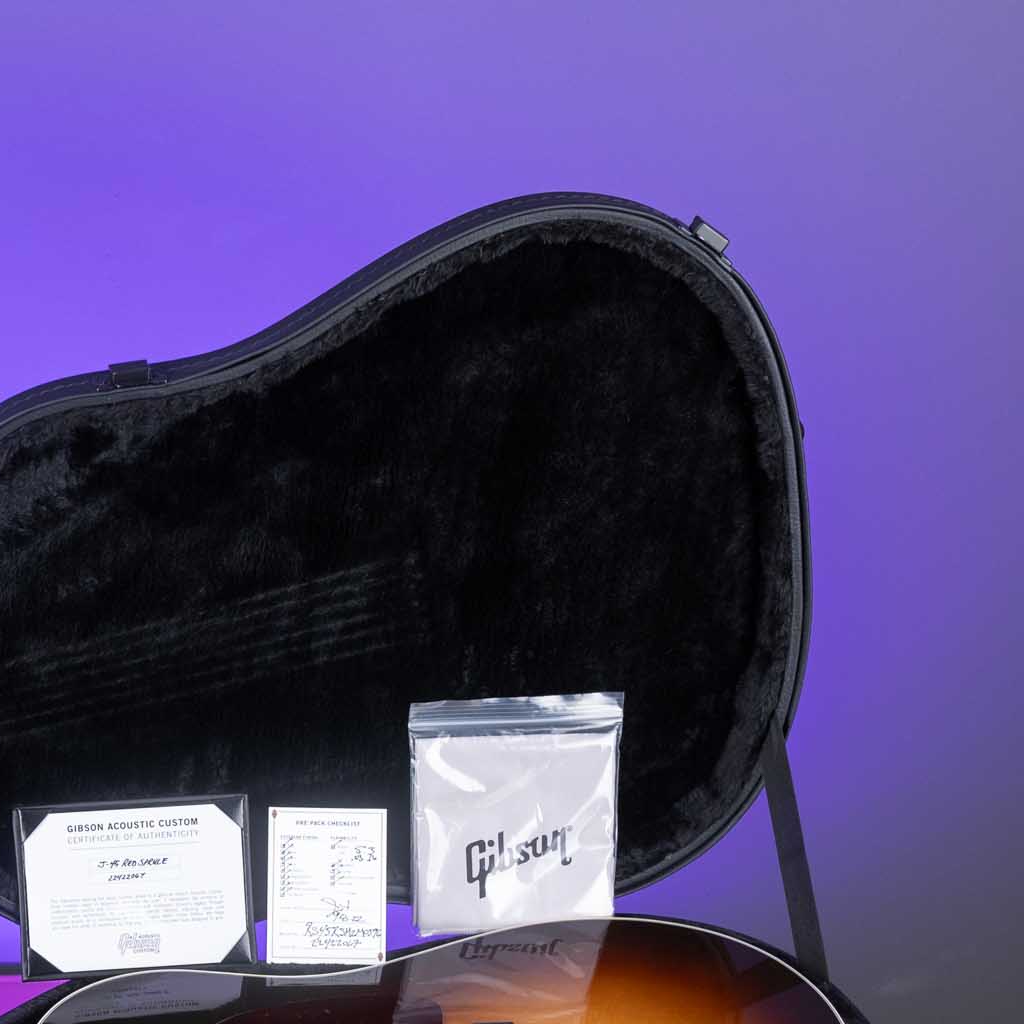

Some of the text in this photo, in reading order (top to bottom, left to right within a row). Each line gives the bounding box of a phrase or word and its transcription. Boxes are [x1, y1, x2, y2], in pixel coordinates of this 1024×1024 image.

[67, 817, 199, 833] GIBSON ACOUSTIC CUSTOM
[67, 829, 200, 845] CERTIFICATE OF AUTHENTICITY
[466, 825, 573, 899] Gibson
